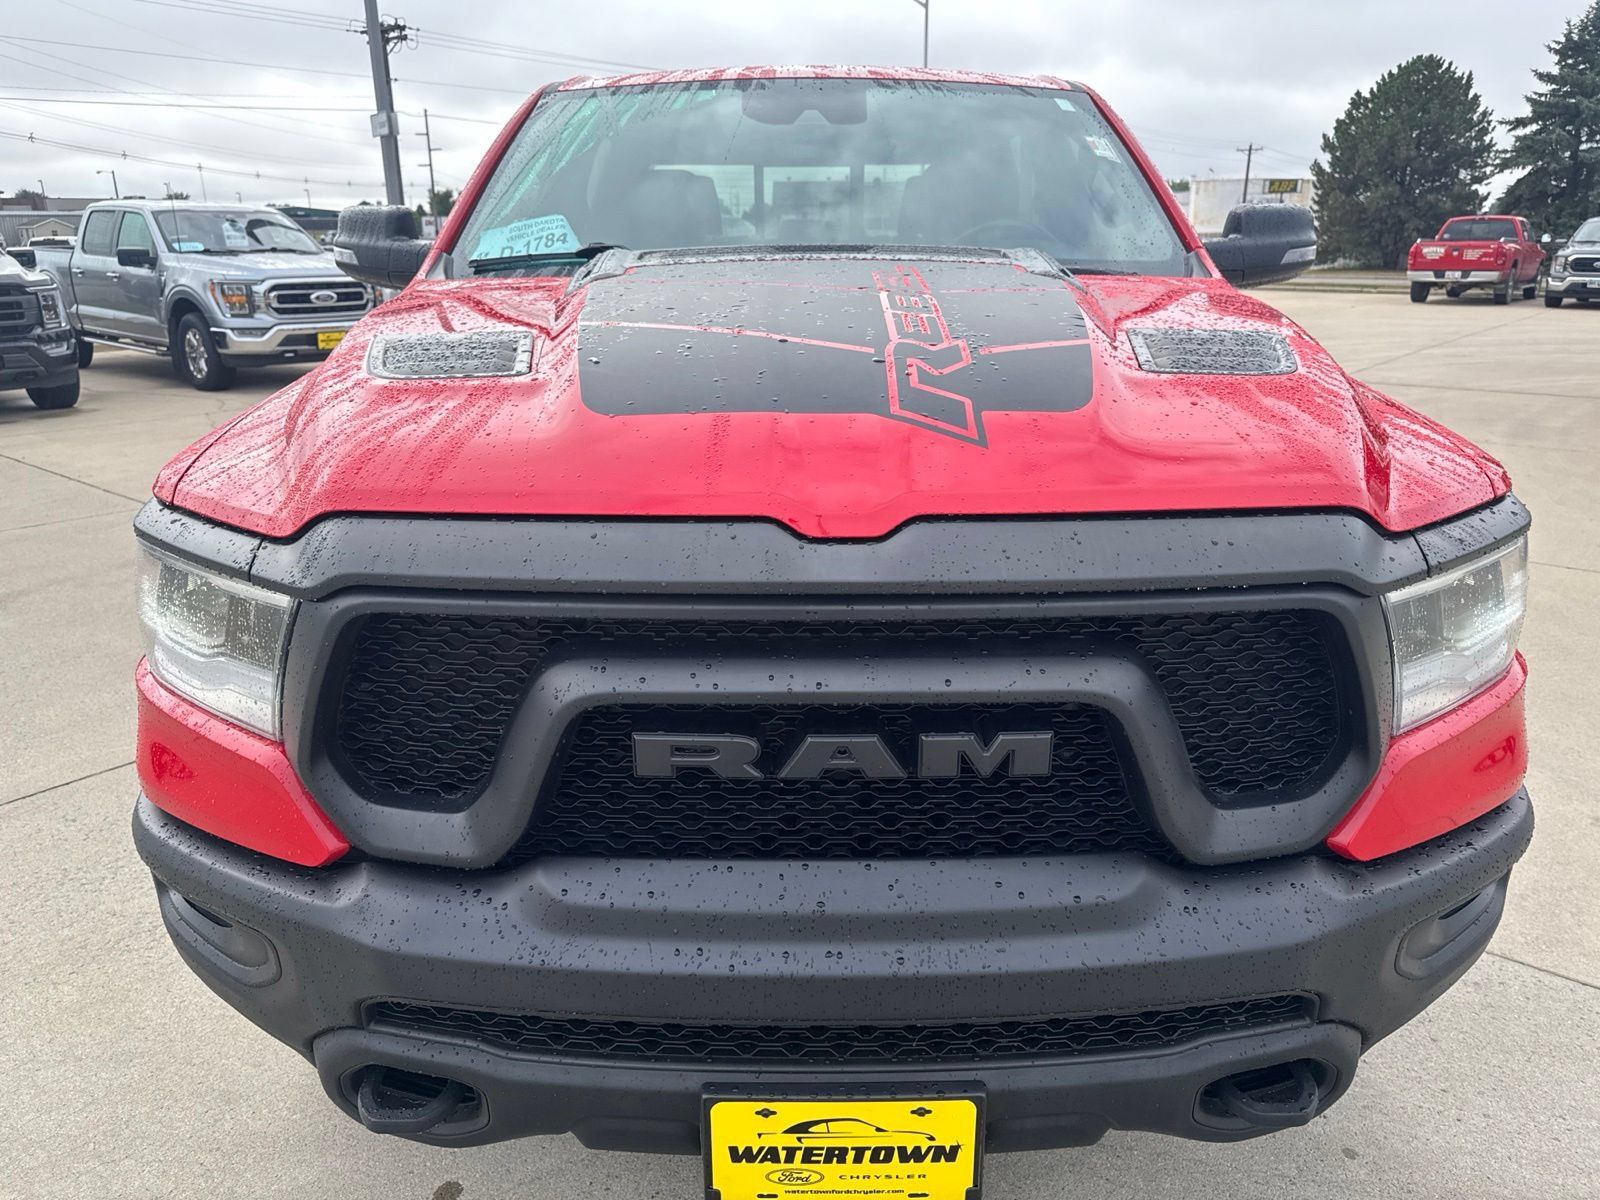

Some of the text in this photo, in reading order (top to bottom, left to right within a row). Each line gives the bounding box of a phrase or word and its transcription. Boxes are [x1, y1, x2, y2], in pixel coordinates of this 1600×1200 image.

[506, 223, 567, 243] VEHICLE DEALER
[508, 217, 565, 234] SOUTH DAKOTA
[500, 231, 569, 257] D-1784
[631, 730, 1054, 779] RAM
[728, 1145, 961, 1165] WATERTOWN
[777, 1171, 927, 1184] Ford CHRYSLER
[784, 1188, 905, 1196] watertownfordchrysler.com
